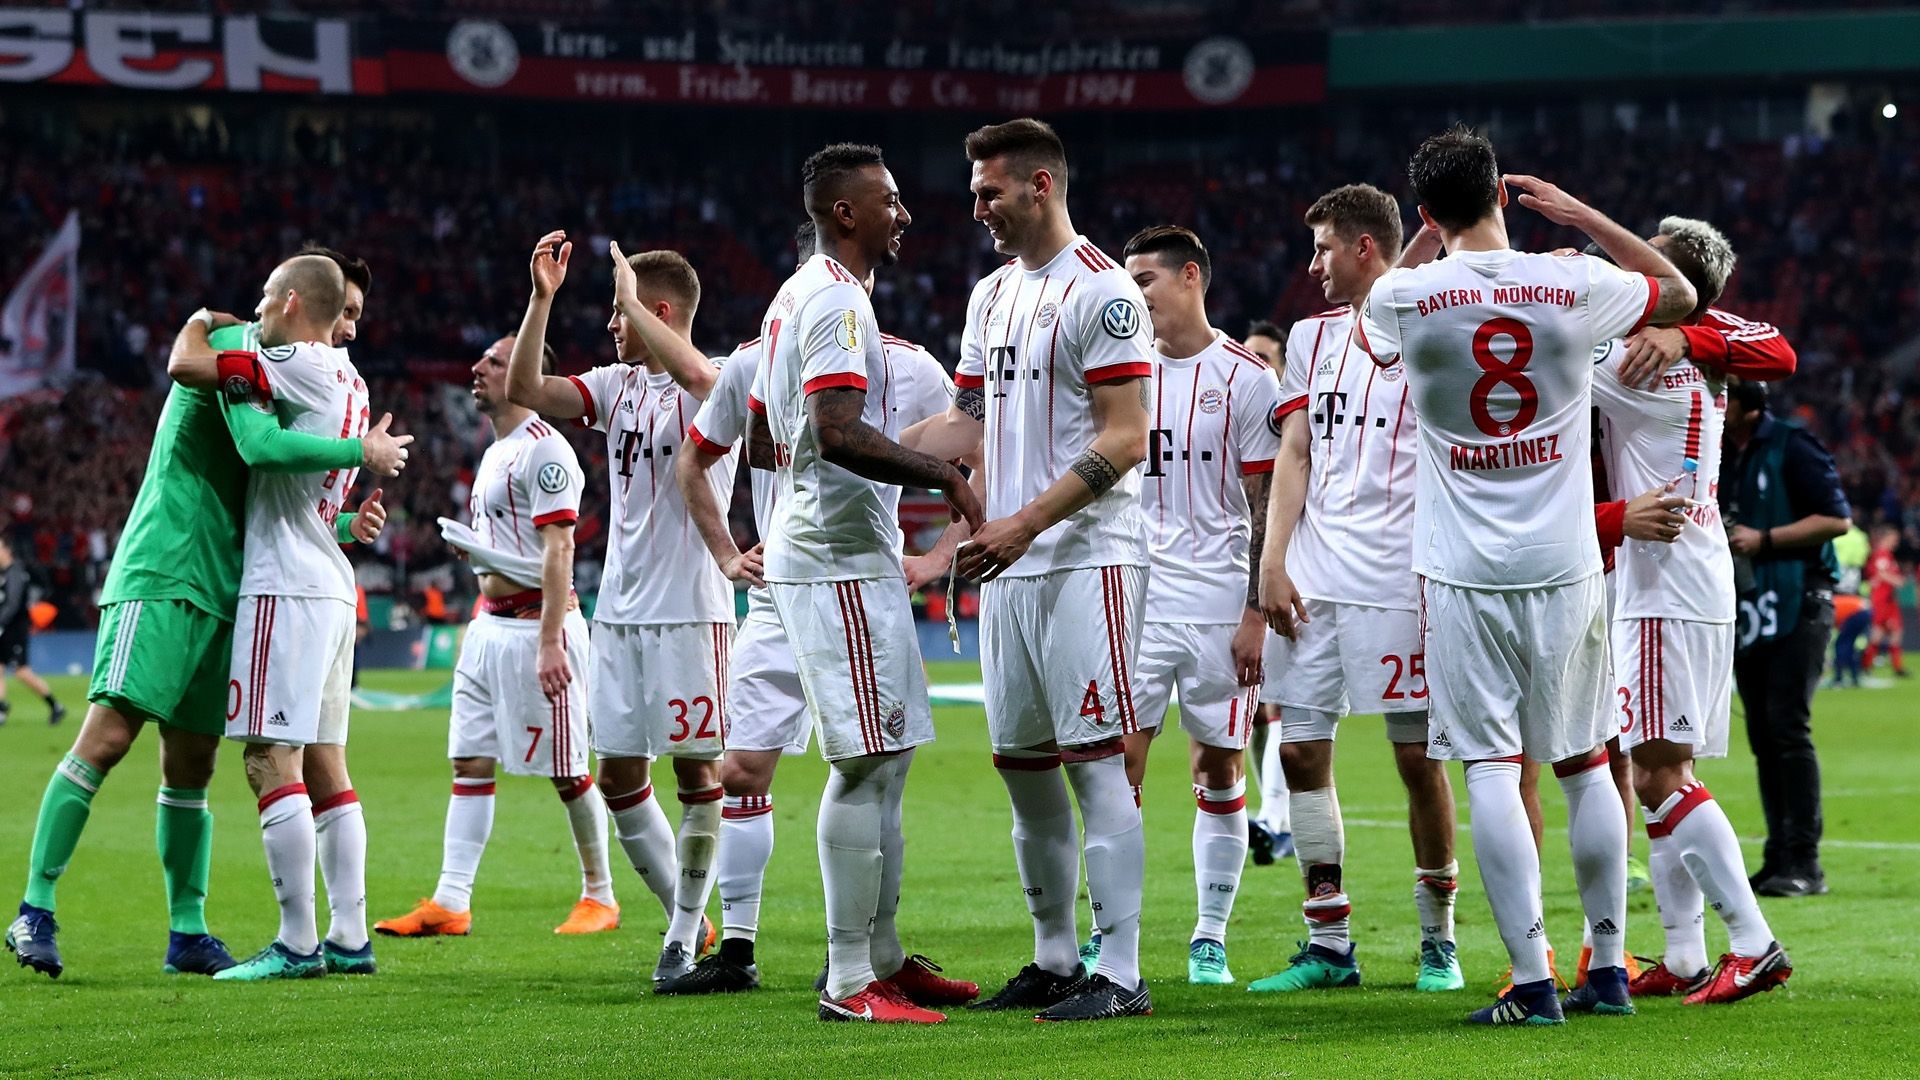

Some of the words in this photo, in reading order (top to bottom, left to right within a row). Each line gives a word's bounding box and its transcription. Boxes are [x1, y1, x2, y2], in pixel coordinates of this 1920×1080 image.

[540, 23, 618, 57] Turn-
[644, 30, 696, 61] und
[886, 38, 927, 69] der
[1417, 289, 1482, 317] BAYERN
[1493, 286, 1576, 308] MÜNCHEN
[1470, 317, 1538, 437] 8
[1451, 434, 1562, 471] MARTÍNEZ
[1380, 654, 1429, 700] 25
[668, 696, 716, 742] 32
[1080, 679, 1105, 726] 4
[1617, 687, 1634, 734] 3
[525, 726, 543, 763] 7
[681, 868, 707, 879] FCB
[1209, 882, 1234, 892] FCB
